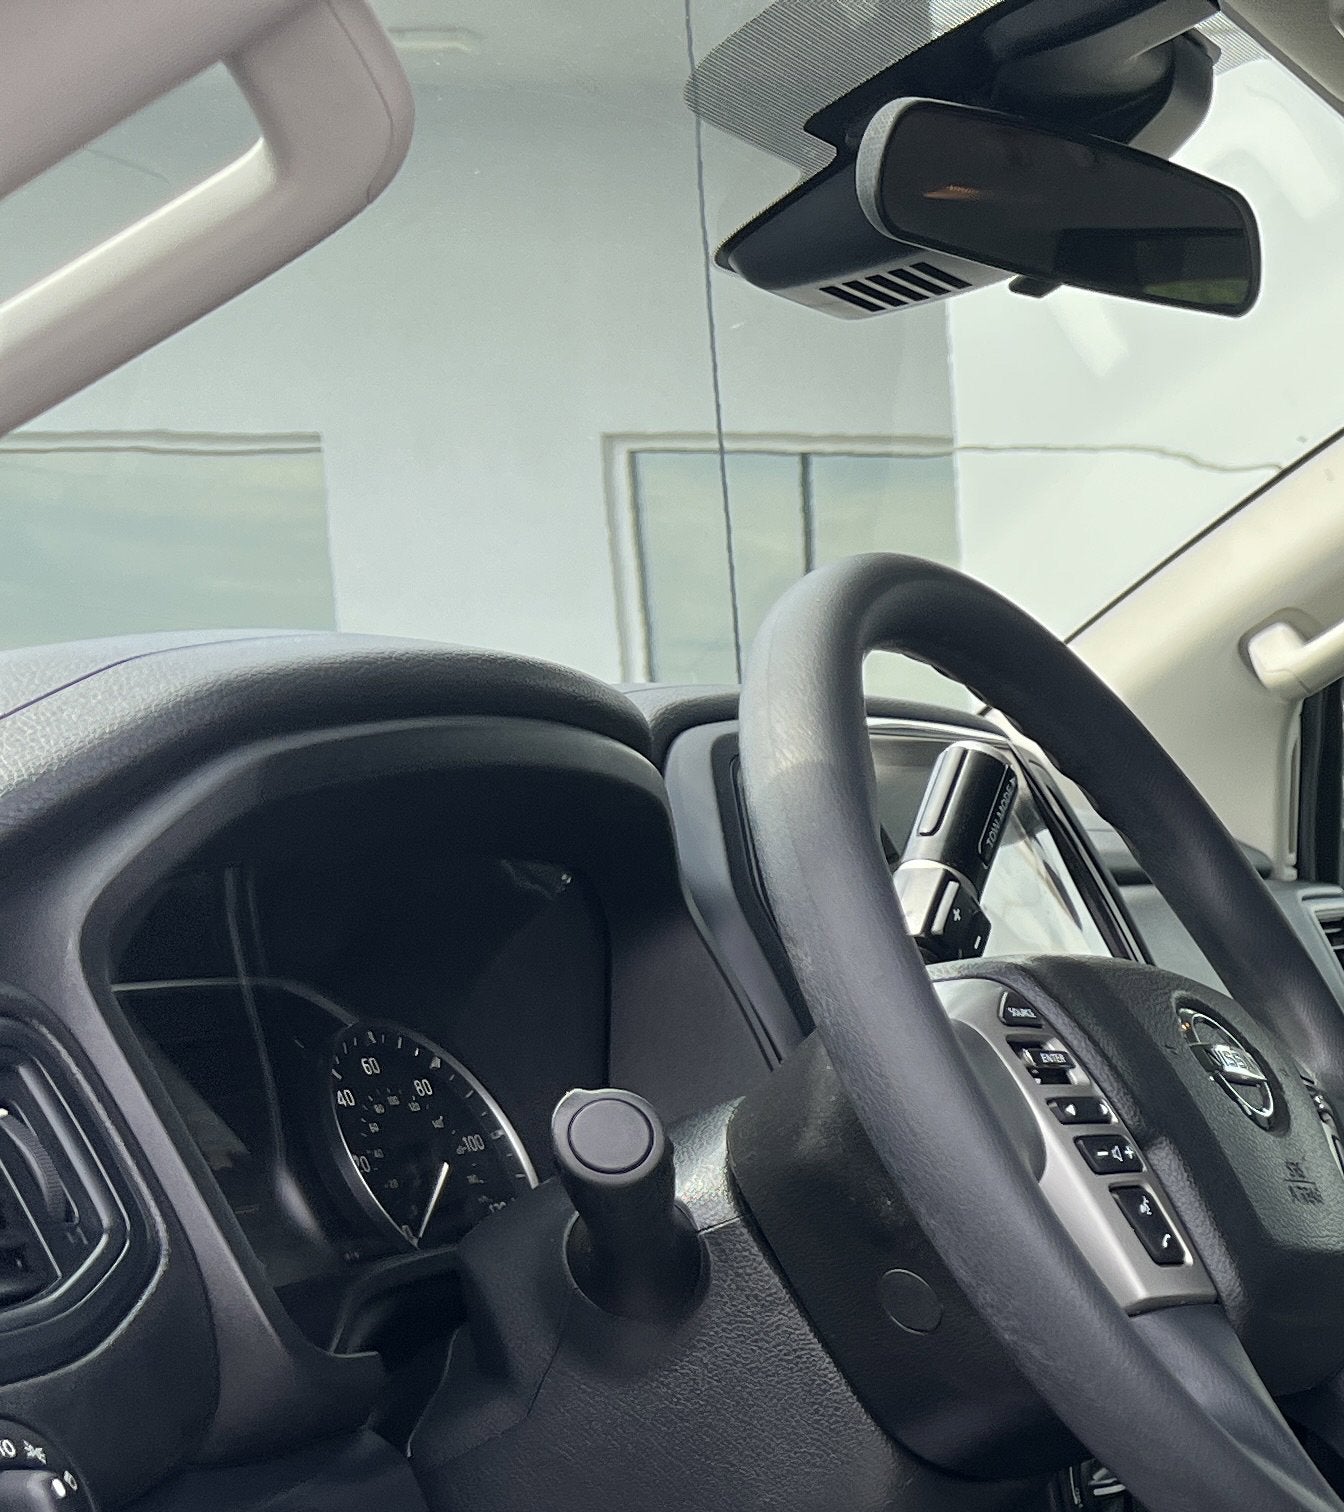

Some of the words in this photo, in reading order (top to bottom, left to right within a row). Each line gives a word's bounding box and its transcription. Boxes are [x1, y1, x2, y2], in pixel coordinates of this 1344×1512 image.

[361, 1057, 381, 1075] 60
[1040, 1053, 1066, 1064] ENTER
[414, 1079, 433, 1096] 80
[337, 1089, 355, 1108] 40
